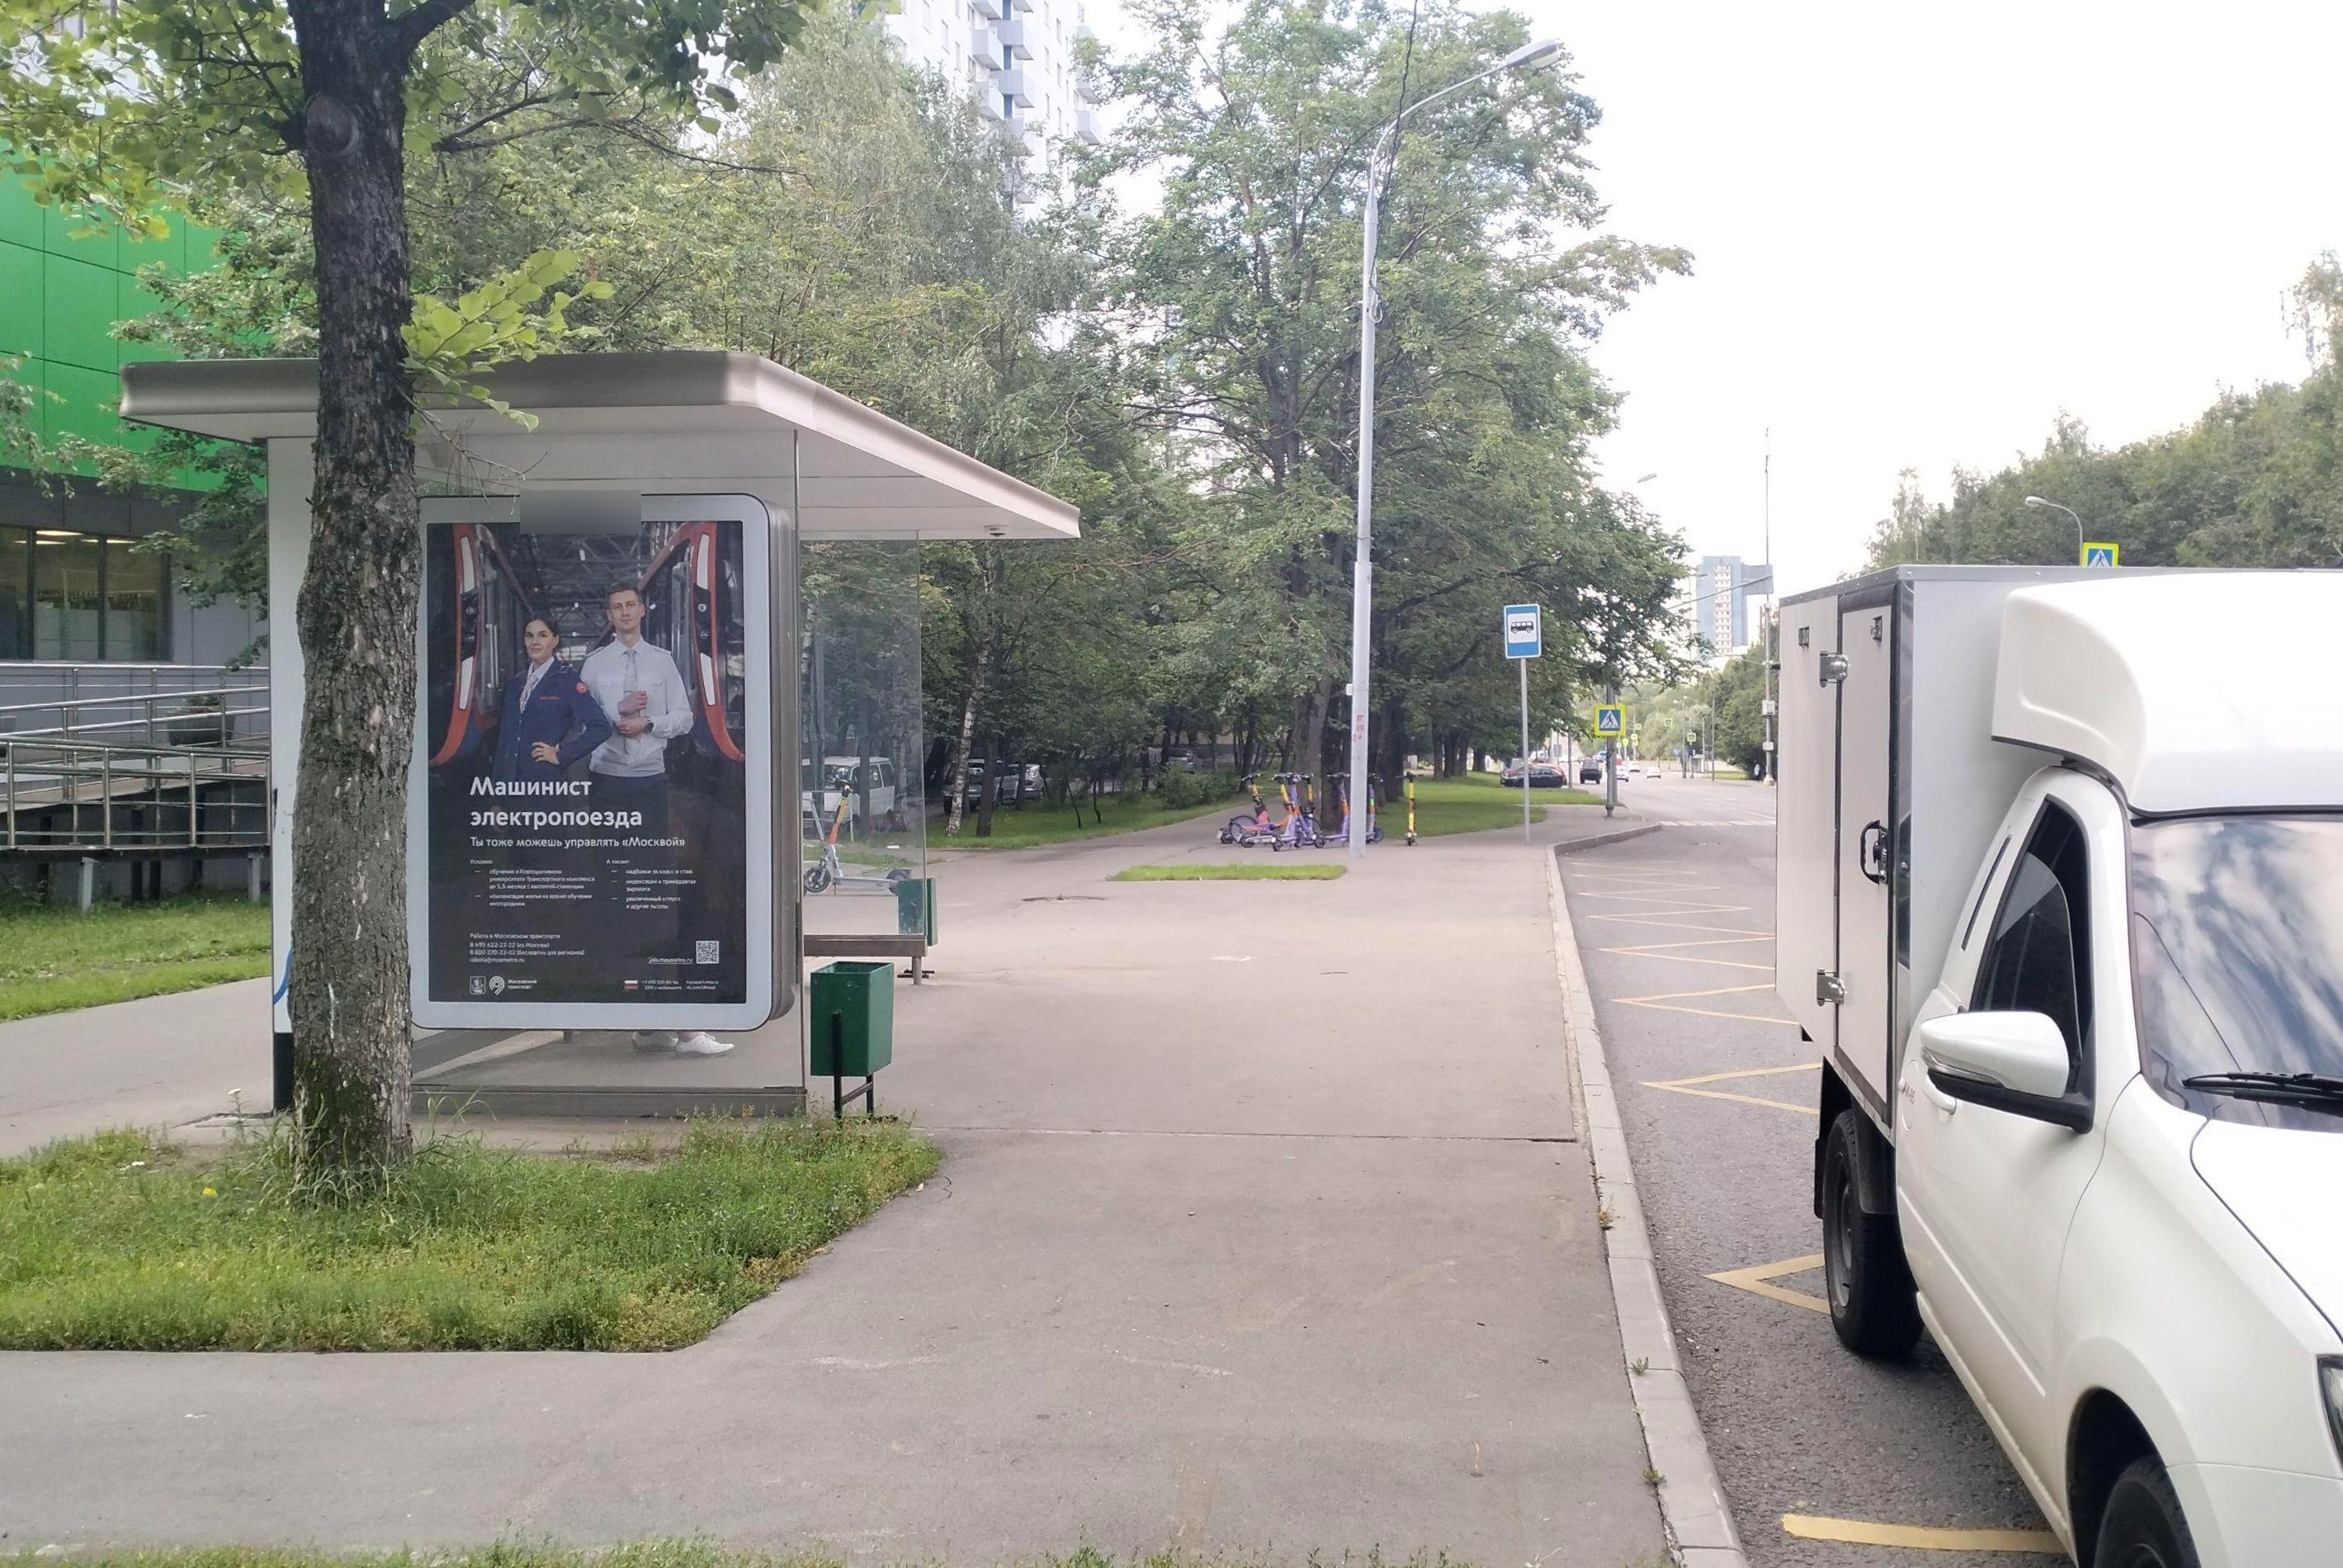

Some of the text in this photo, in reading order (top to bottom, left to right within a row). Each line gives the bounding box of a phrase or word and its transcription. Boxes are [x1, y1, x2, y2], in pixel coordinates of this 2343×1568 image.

[470, 777, 592, 796] Машинист
[470, 811, 642, 830] электропоезда
[470, 837, 686, 849] Ты тоже можешь управлять «Москвой»
